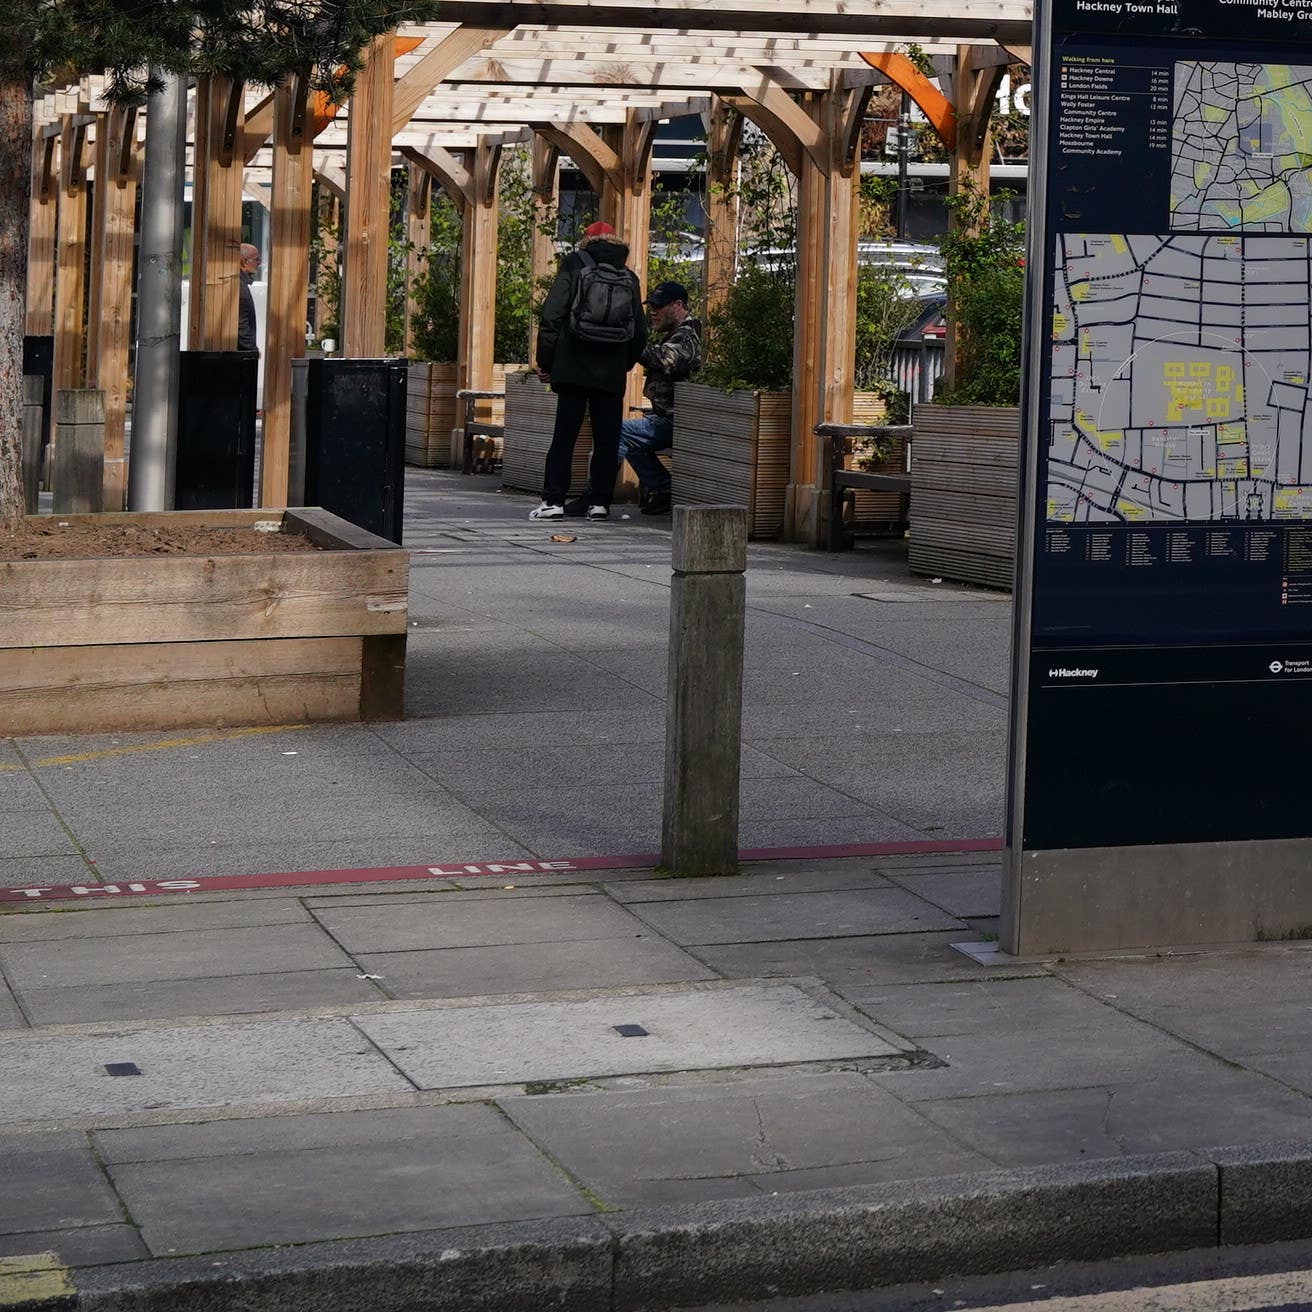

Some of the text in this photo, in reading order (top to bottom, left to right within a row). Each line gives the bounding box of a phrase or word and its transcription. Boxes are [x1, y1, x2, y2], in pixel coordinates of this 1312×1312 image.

[1077, 1, 1178, 15] Hackney Town Hall
[1257, 10, 1293, 21] Mabley
[1059, 668, 1098, 679] Hackney
[10, 861, 577, 897] THIS LINE
